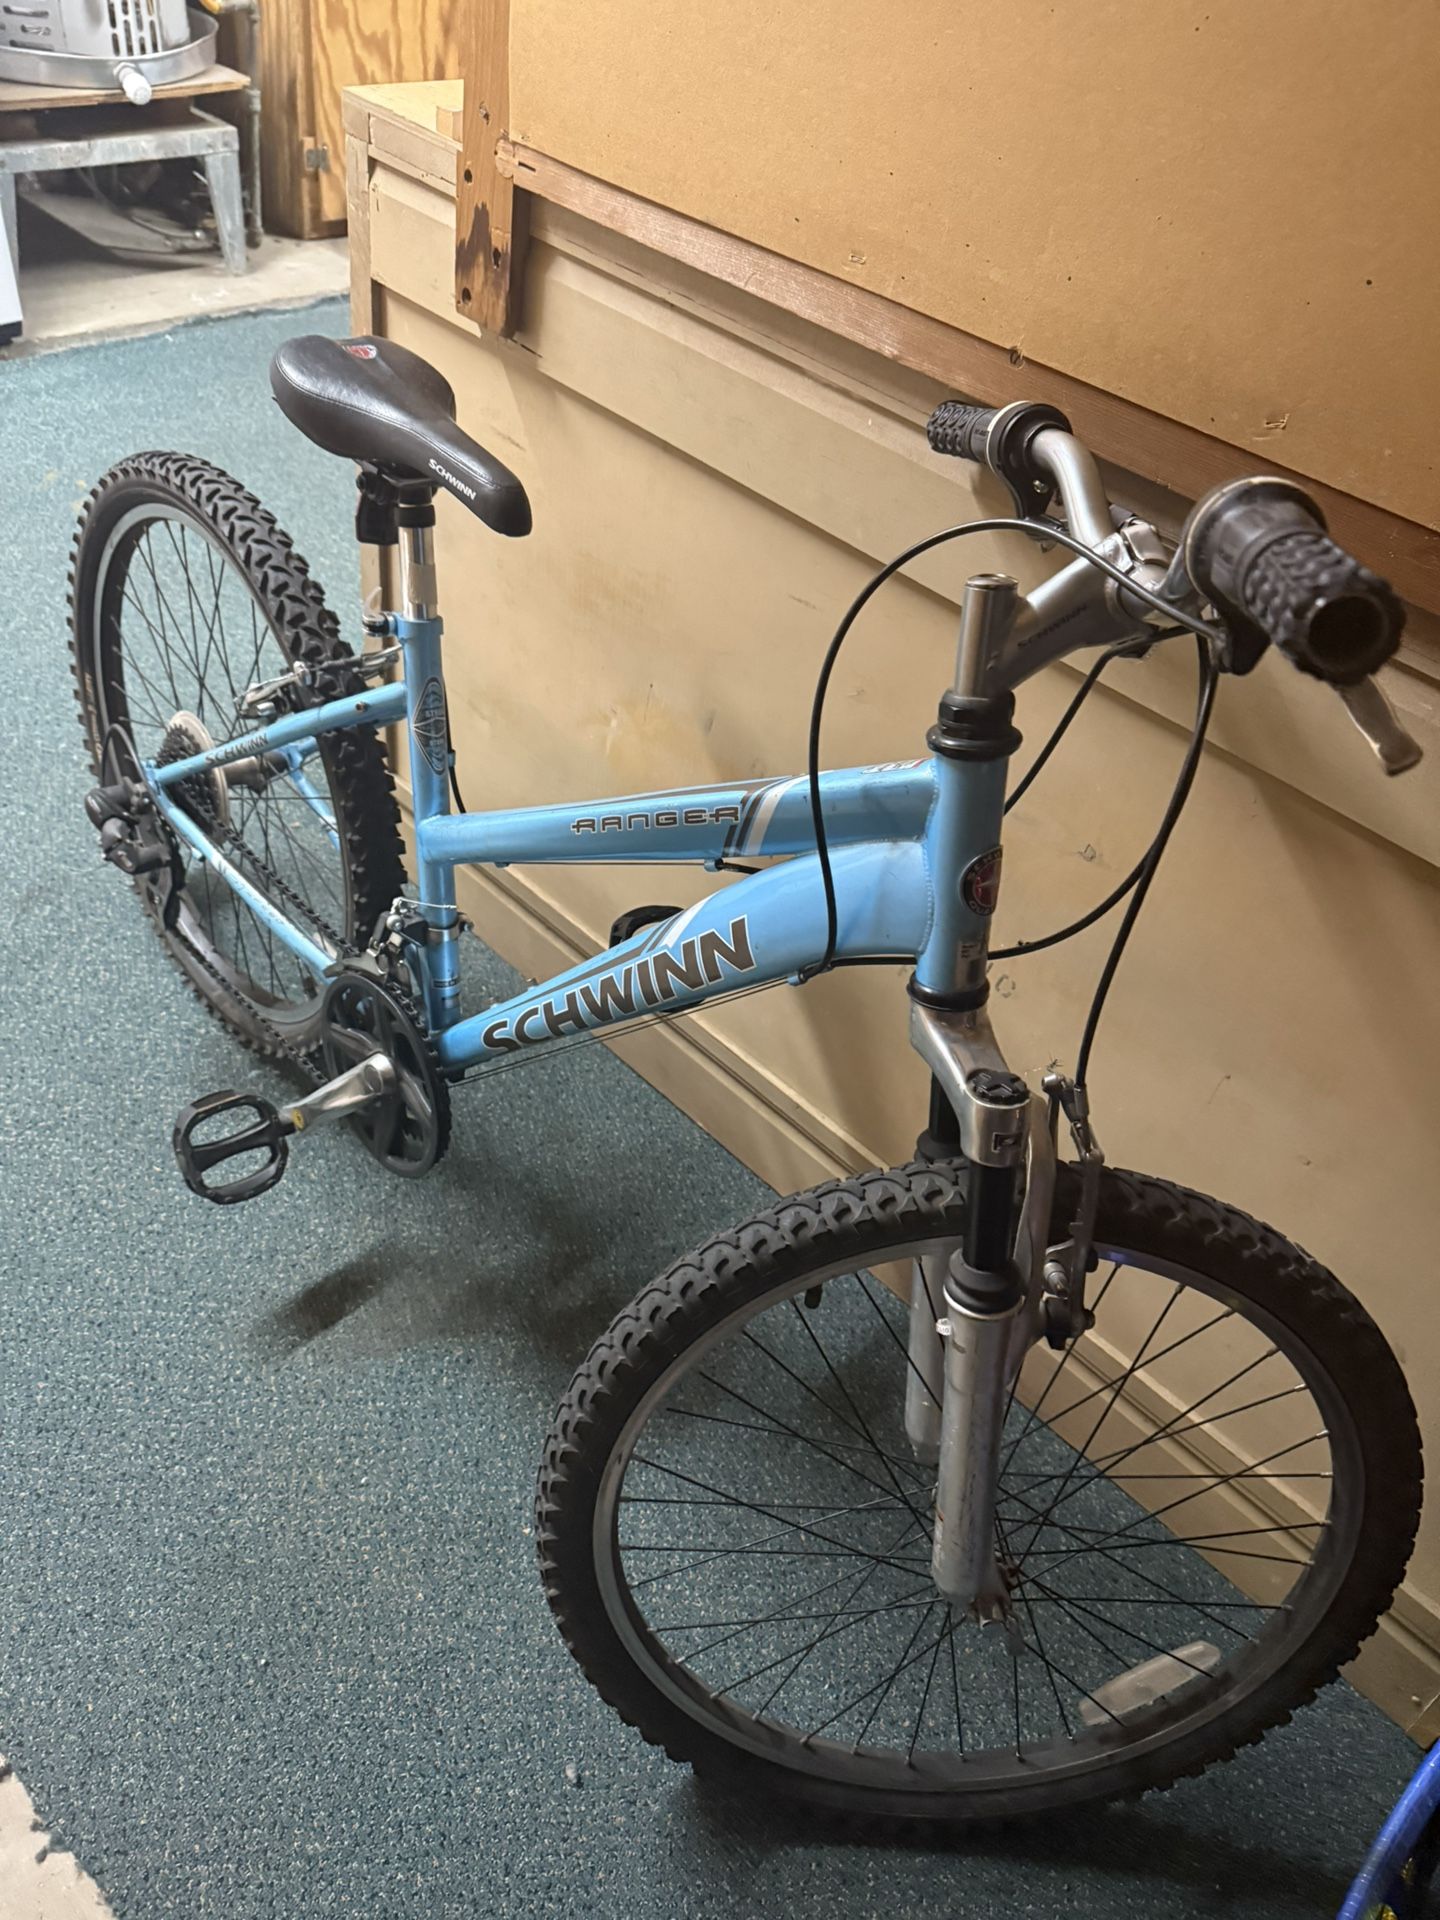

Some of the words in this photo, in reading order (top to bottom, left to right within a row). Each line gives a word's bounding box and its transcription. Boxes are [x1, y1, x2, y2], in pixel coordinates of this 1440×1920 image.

[428, 458, 477, 500] SCHWINN
[205, 732, 269, 767] SCHWINN
[571, 805, 741, 835] RANGER
[481, 914, 757, 1051] SCHWINN
